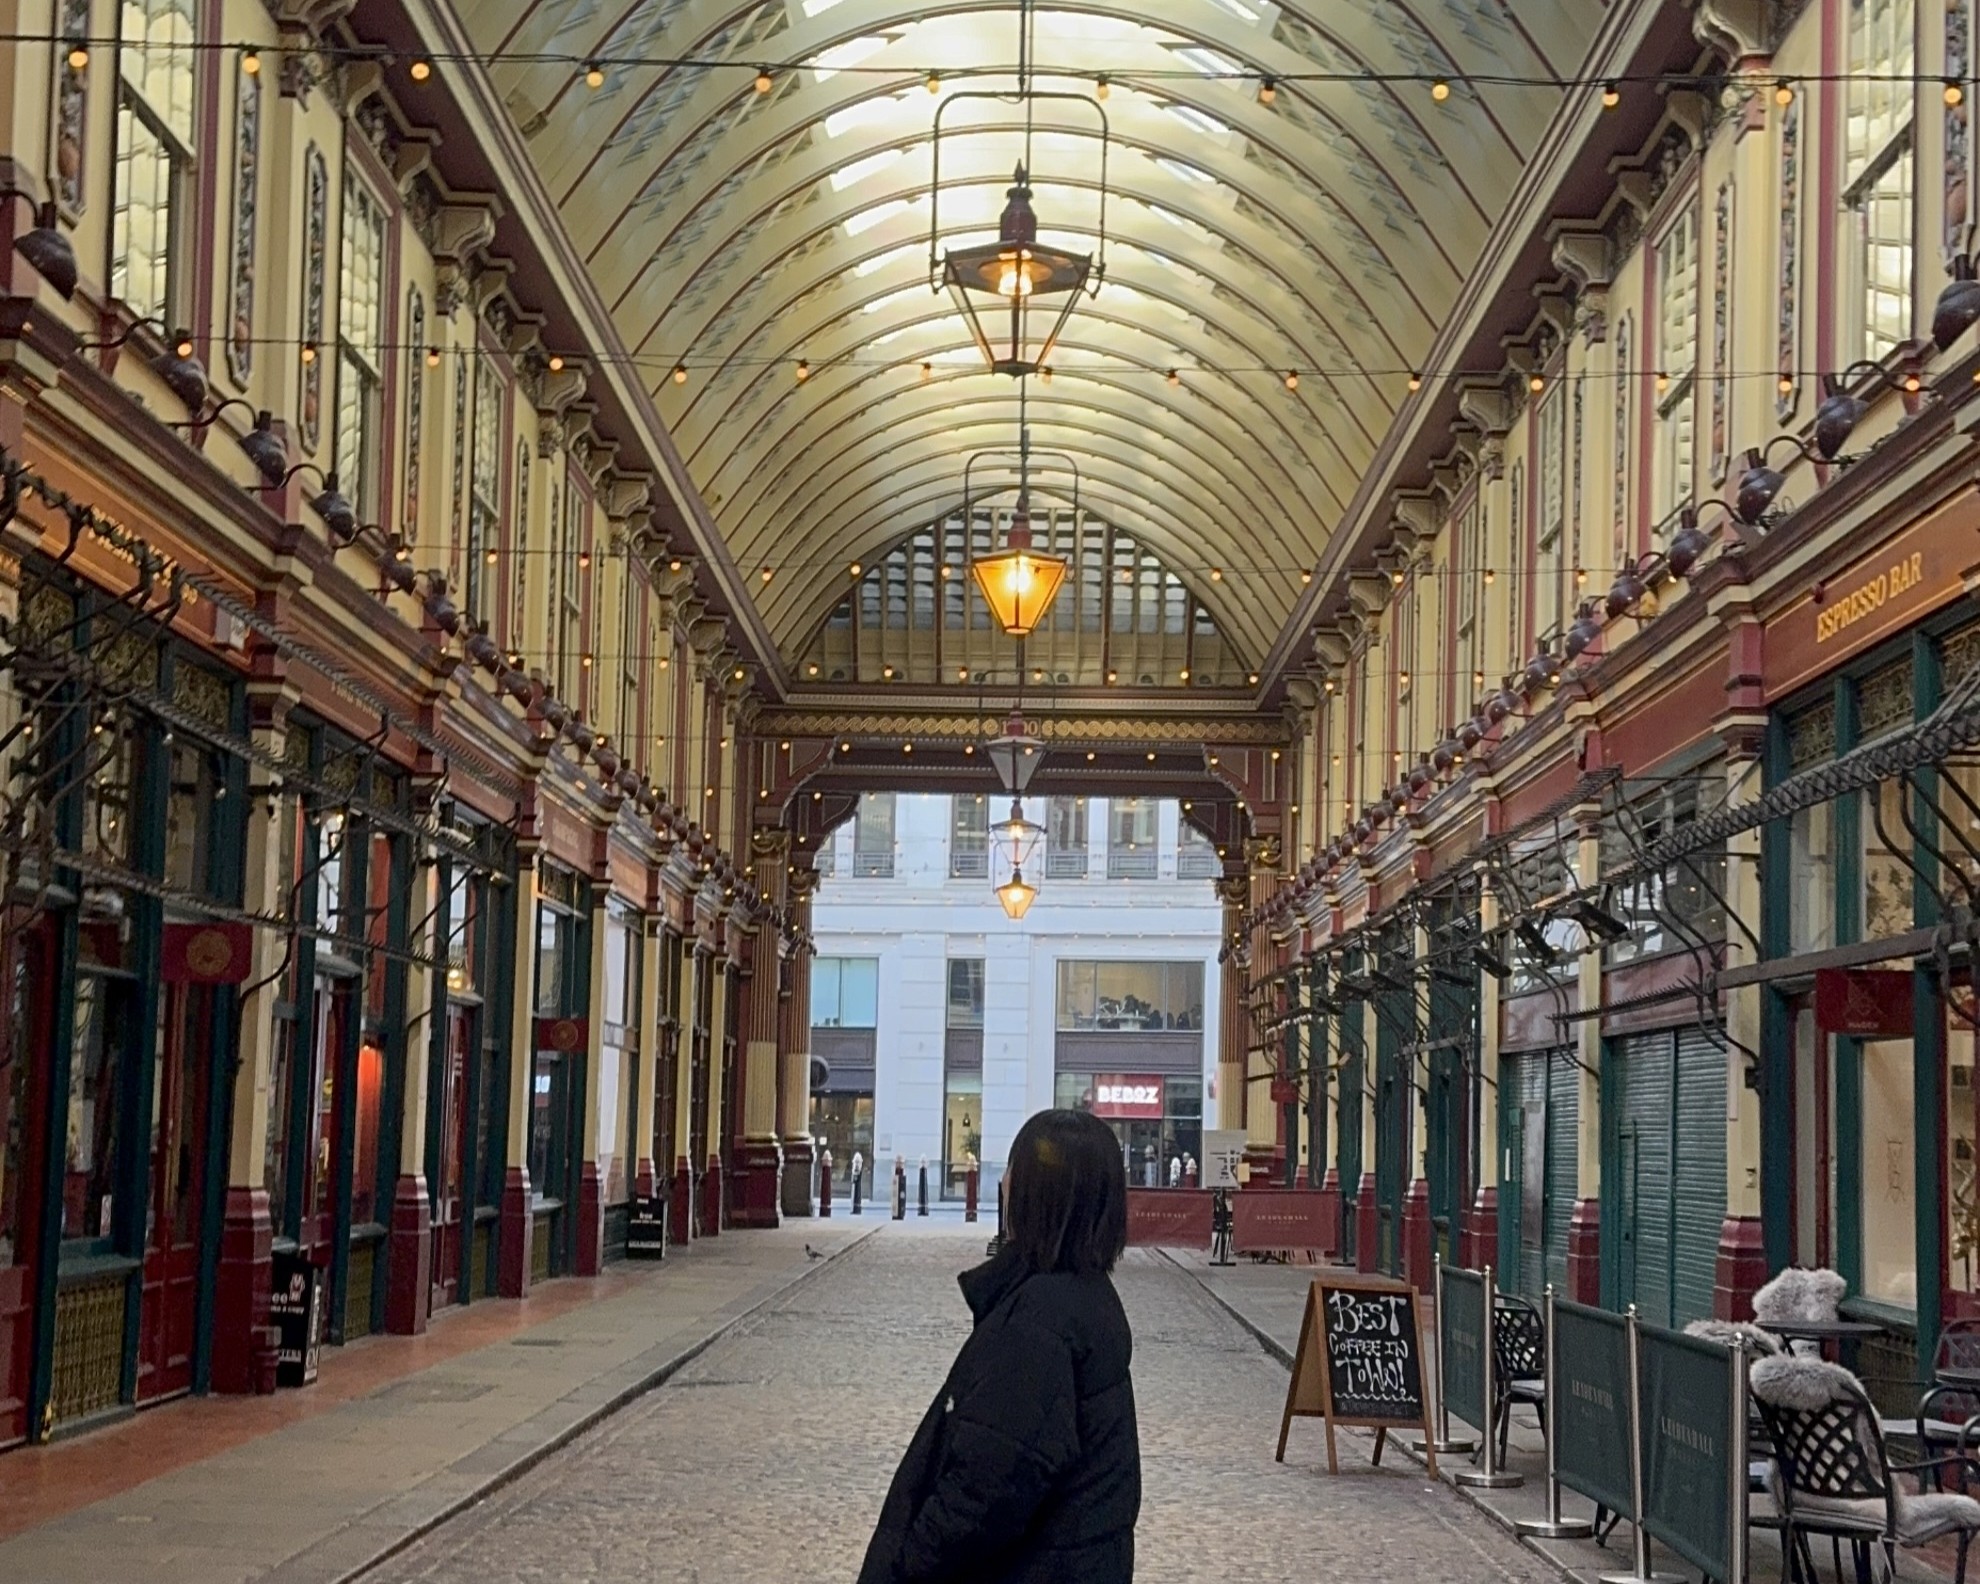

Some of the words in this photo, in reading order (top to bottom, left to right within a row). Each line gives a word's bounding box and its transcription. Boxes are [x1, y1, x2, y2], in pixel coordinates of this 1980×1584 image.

[1816, 574, 1888, 644] ESPRESSO
[1889, 551, 1924, 599] BAR
[1002, 720, 1038, 736] 10
[1328, 1290, 1408, 1337] BEST
[1329, 1332, 1382, 1357] COFFEE
[1384, 1339, 1409, 1359] IN
